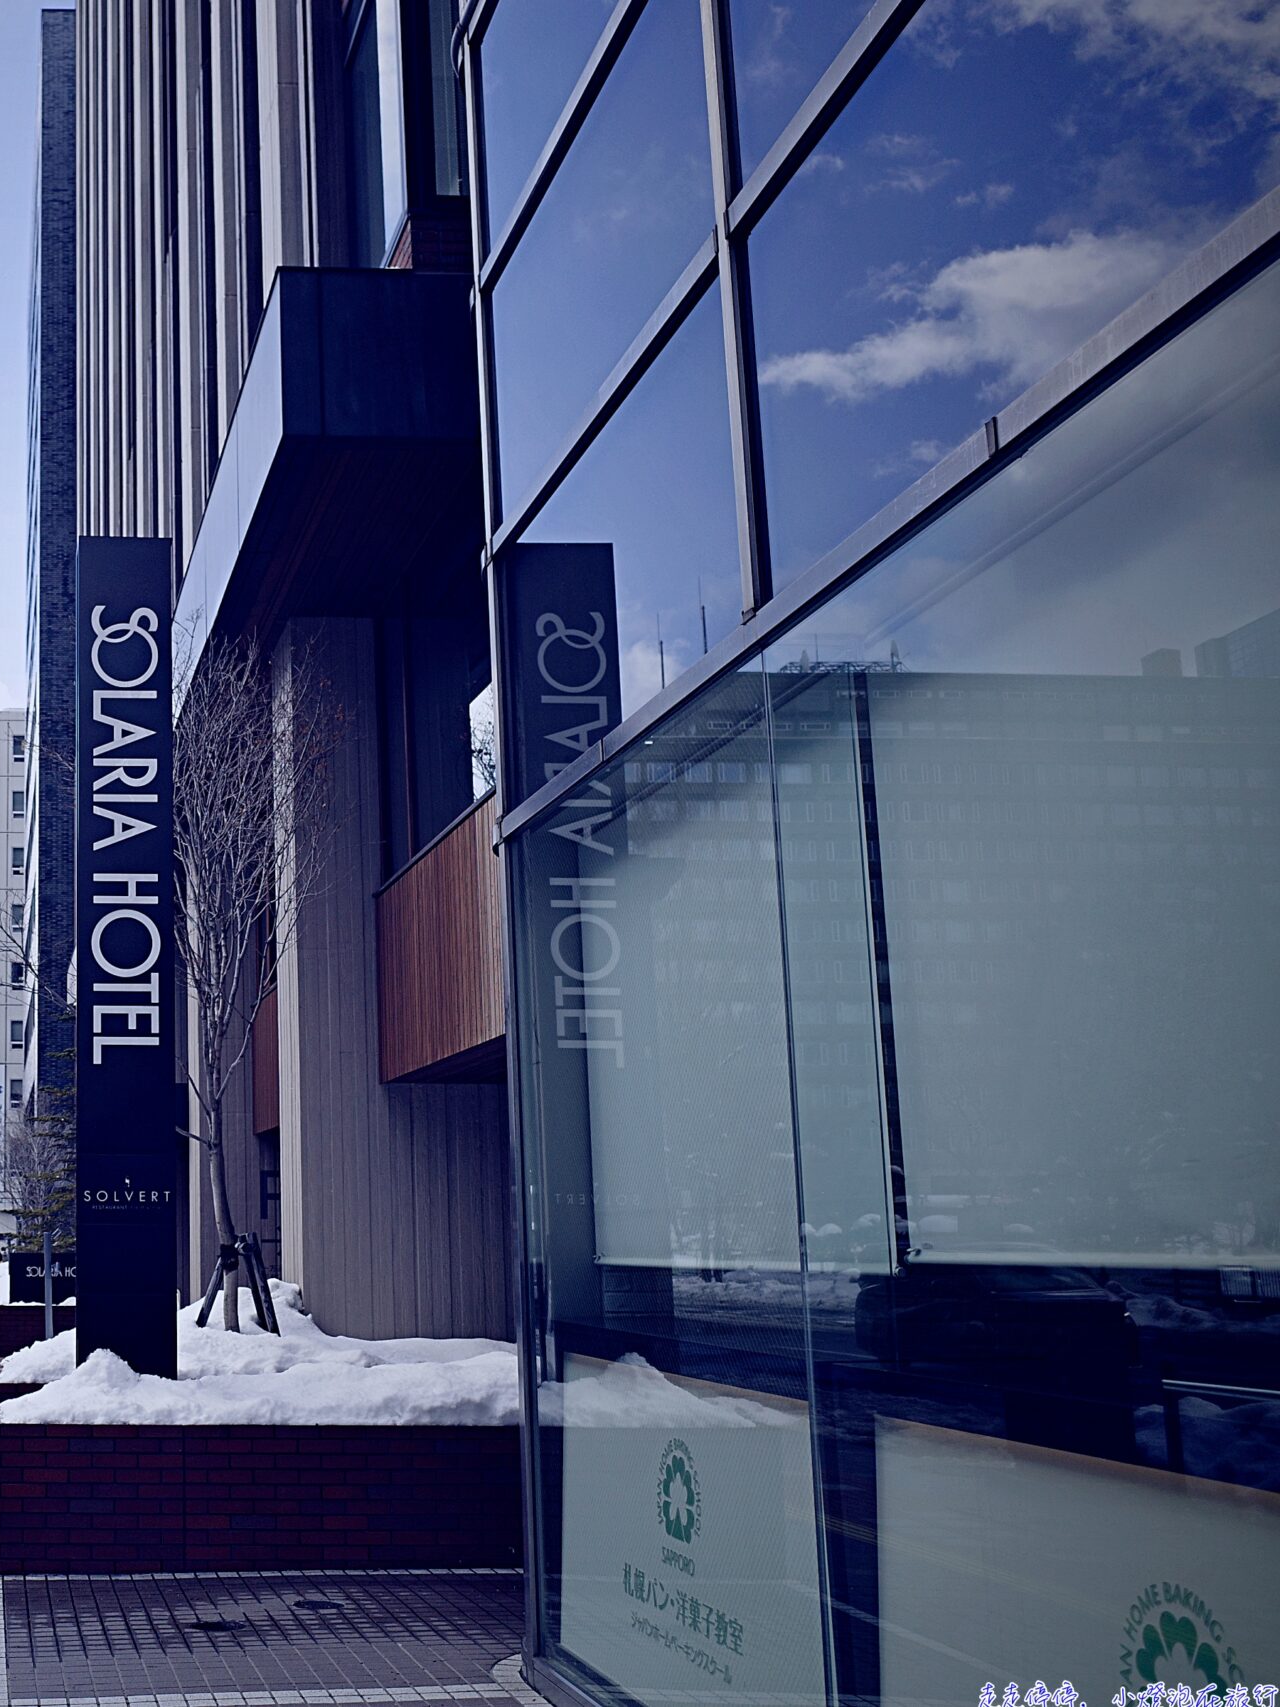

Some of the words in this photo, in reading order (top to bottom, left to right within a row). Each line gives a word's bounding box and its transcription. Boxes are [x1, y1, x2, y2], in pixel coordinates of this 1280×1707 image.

[90, 604, 159, 852] SOLARIA
[91, 872, 162, 1066] HOTEL
[84, 1190, 171, 1202] SOLVERT
[26, 1266, 63, 1278] SOLIA
[1123, 1583, 1161, 1643] HOME
[1162, 1581, 1225, 1643] BAKING
